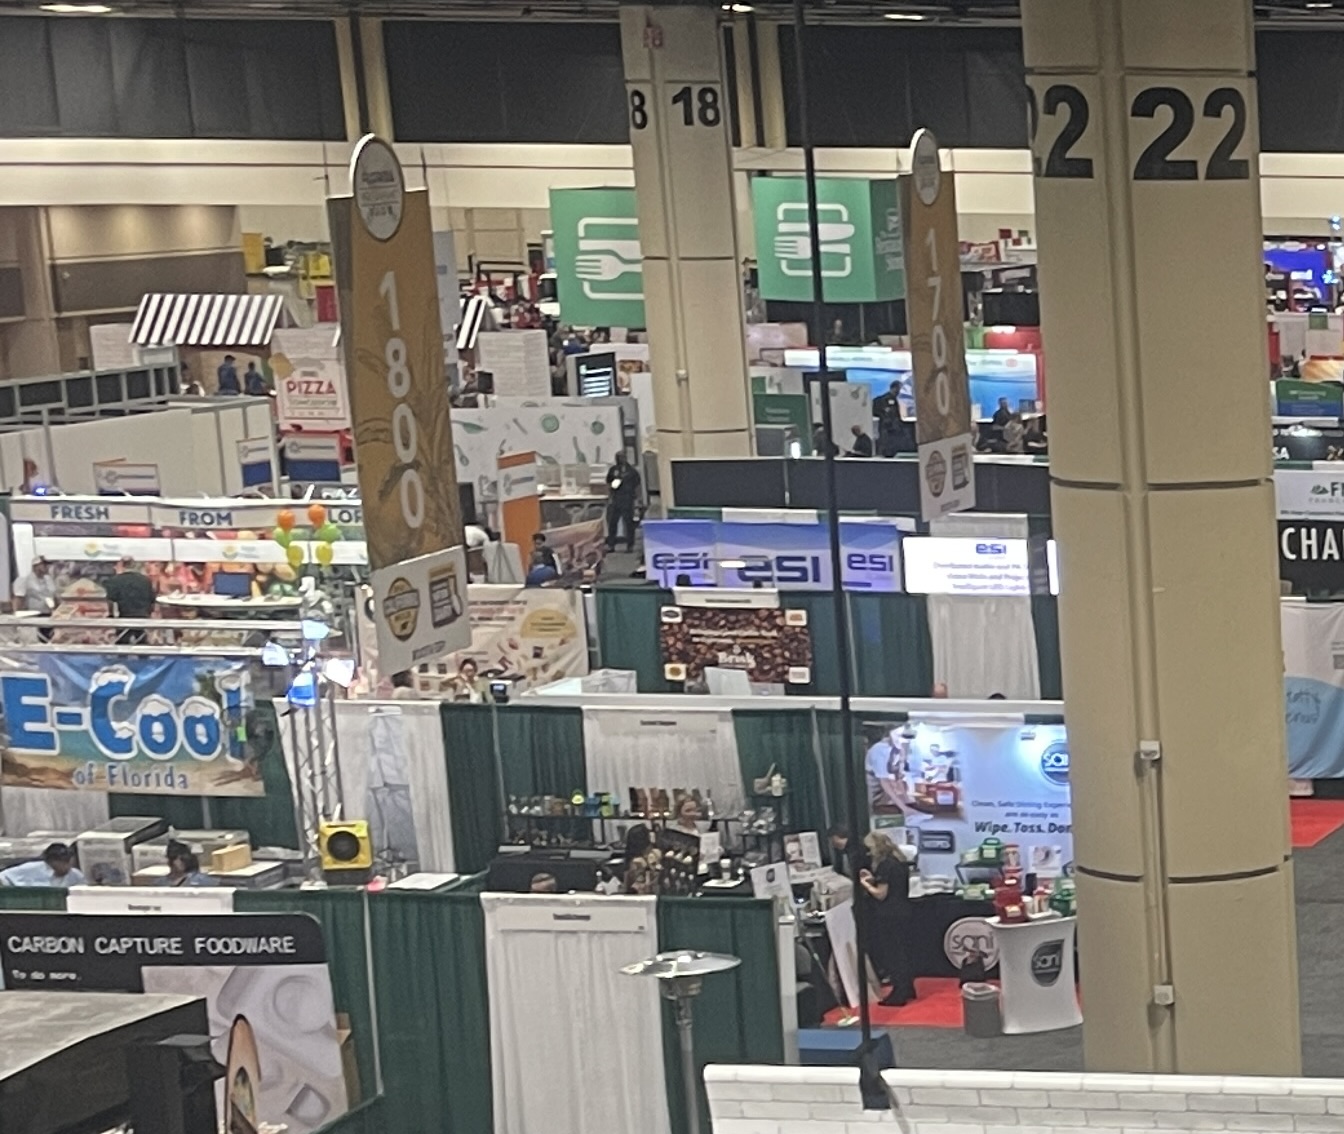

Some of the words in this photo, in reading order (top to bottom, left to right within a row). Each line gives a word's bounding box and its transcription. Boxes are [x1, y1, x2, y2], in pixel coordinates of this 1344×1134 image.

[671, 86, 720, 127] 18
[1130, 87, 1250, 180] 22
[925, 227, 950, 416] 1700
[286, 380, 337, 395] PIZZA
[378, 270, 425, 529] 1800
[51, 504, 110, 521] FRESH
[178, 510, 234, 527] FROM
[975, 543, 1007, 555] esi
[846, 553, 894, 572] esi
[74, 762, 95, 786] of
[107, 763, 189, 790] Florida
[7, 936, 84, 954] CARBON
[94, 936, 184, 955] CAPTURE
[194, 935, 297, 954] FOODWARE
[952, 931, 994, 950] sani
[30, 970, 46, 980] do
[49, 970, 82, 981] more.
